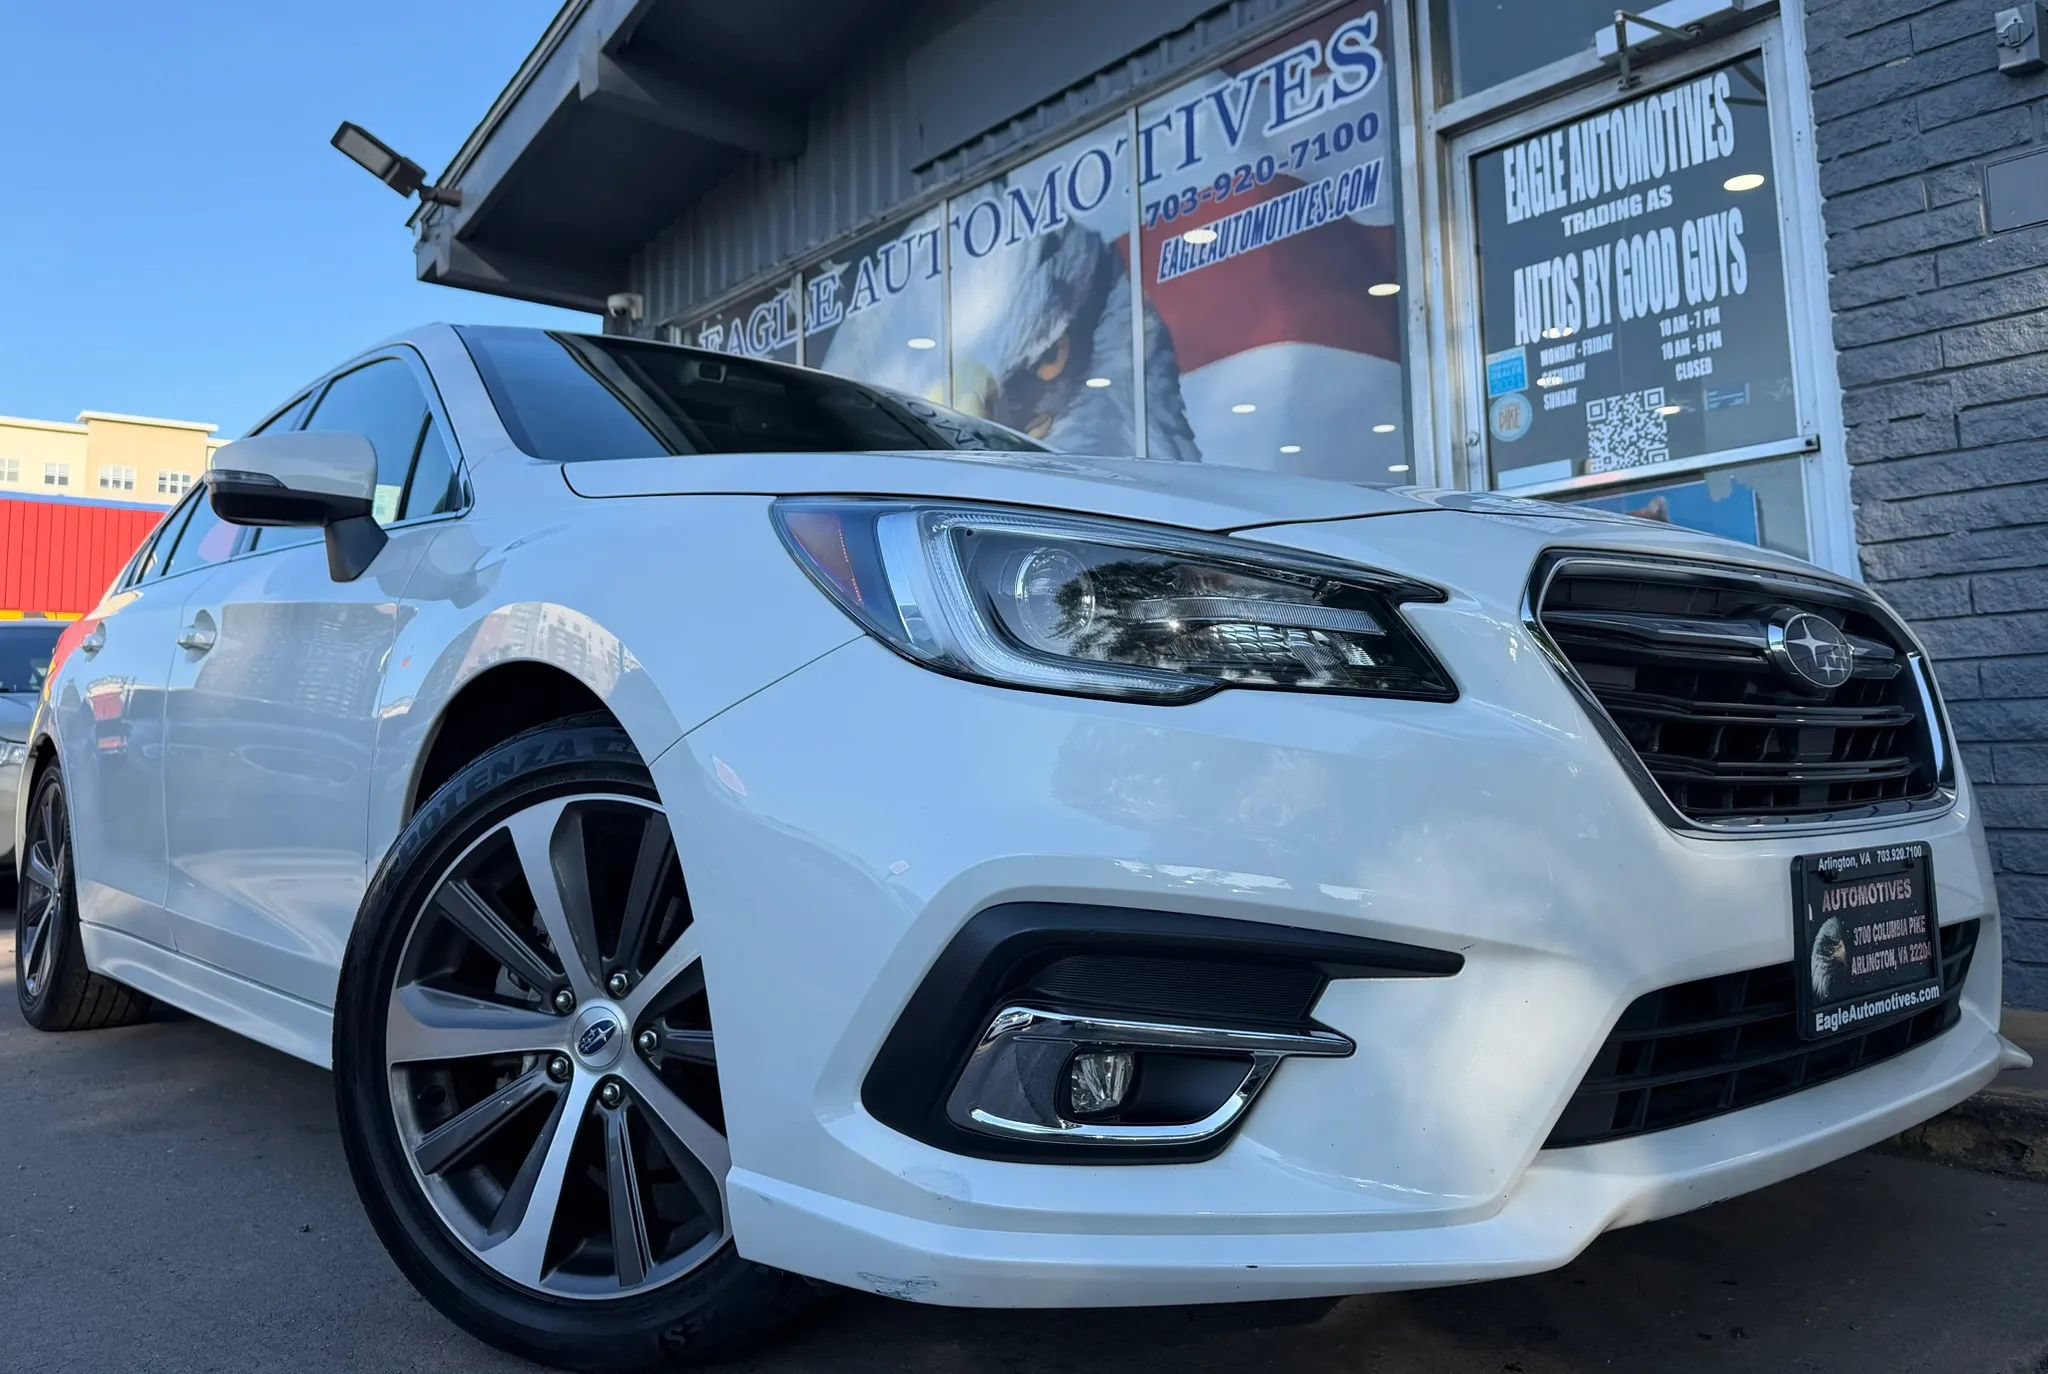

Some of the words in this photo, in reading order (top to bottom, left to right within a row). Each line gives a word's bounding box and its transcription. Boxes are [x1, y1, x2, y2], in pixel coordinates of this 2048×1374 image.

[847, 10, 1385, 316] AUTOMOTIVES
[1503, 129, 1567, 225] EAGLE
[1568, 72, 1735, 205] AUTOMOTIVES
[1146, 111, 1379, 229] 703-920-7100
[1157, 158, 1384, 283] EAGLEAUTOMOTIVES.COM
[1561, 193, 1643, 238] TRADING
[1646, 184, 1673, 213] AS
[1513, 252, 1582, 346] AUTOS
[1583, 243, 1612, 329] BY
[1615, 226, 1680, 322] GOOD
[1681, 206, 1748, 306] GUYS
[1659, 318, 1672, 338] 10
[1672, 314, 1689, 334] AM
[1695, 310, 1701, 329] 7
[1703, 306, 1721, 327] PM
[1540, 342, 1577, 368] MONDAY
[1582, 332, 1614, 358] FRIDAY
[1661, 342, 1674, 361] 10
[1674, 337, 1691, 357] AM
[1697, 334, 1705, 352] 6
[1706, 330, 1723, 351] PM
[1675, 357, 1713, 382] CLOSED
[1543, 387, 1578, 411] SUNDAY
[1818, 855, 1858, 872] Arlington,
[1860, 852, 1871, 866] VA
[1877, 845, 1922, 863] 703.920.7100
[1822, 878, 1912, 912] AUTOMOTIVES
[1872, 918, 1908, 942] COLUMBIA
[1908, 915, 1926, 935] PIKE
[1851, 948, 1897, 976] ARLINGTON,
[1898, 946, 1908, 965] VA
[1815, 984, 1940, 1031] EagleAutomotives.com
